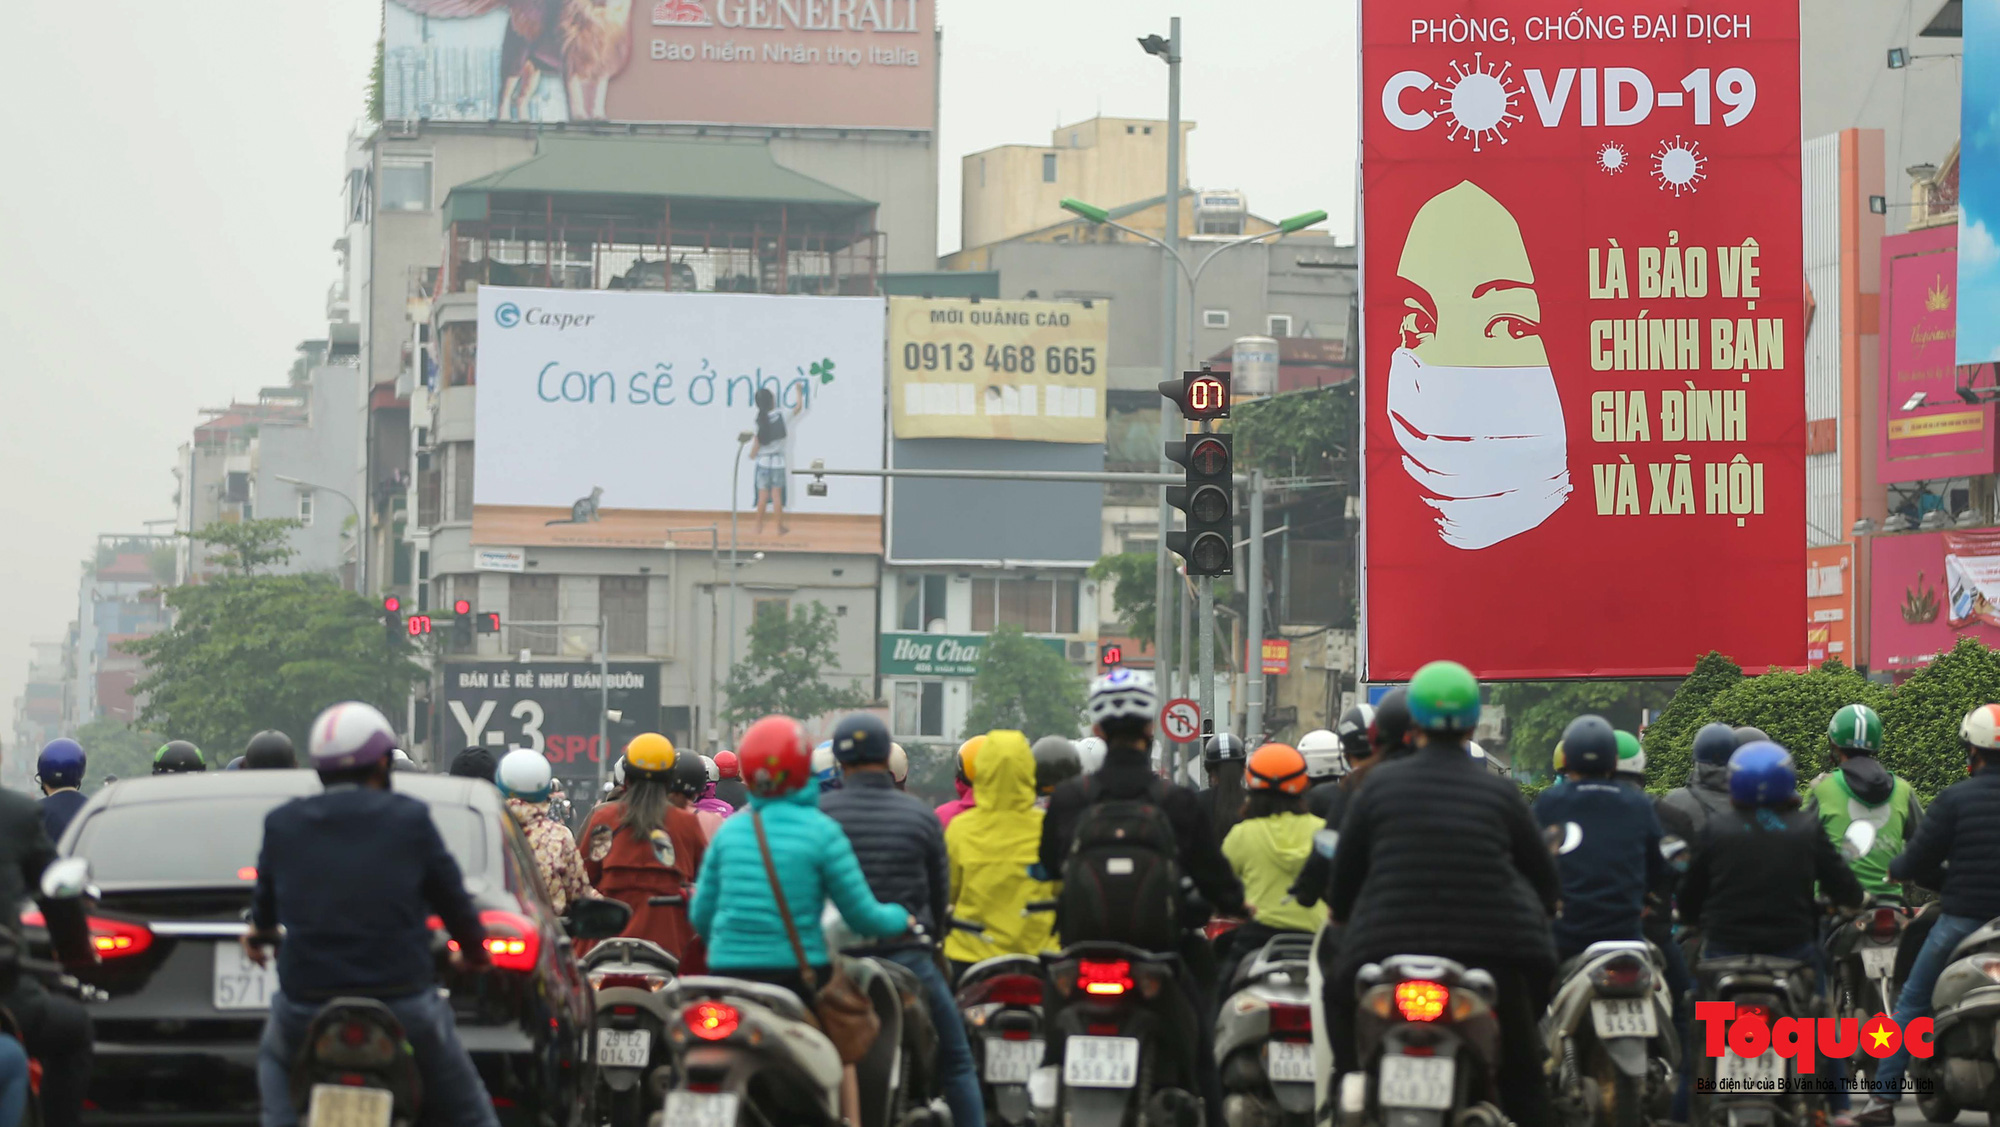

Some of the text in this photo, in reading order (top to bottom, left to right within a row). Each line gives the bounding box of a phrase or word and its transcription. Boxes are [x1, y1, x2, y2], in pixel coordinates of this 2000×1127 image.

[715, 0, 921, 33] GENERALI
[1411, 8, 1752, 45] PHÒNG, CHỐNG ĐẠI DỊCH
[869, 46, 920, 66] Italia
[1381, 58, 1758, 142] COVID-19
[1588, 230, 1761, 310] LÀ BẢO VỆ
[525, 306, 596, 331] Casper
[904, 342, 1097, 375] 0913 468 665
[1590, 309, 1784, 383] CHÍNH BẠN
[537, 357, 811, 409] Con sẽ ở nhà
[1192, 381, 1223, 409] 07
[1591, 380, 1748, 442] GIA ĐÌNH
[1592, 453, 1764, 527] VÀ XÃ HỘI
[408, 614, 432, 635] 07
[893, 638, 933, 661] Hoa
[459, 670, 488, 688] BÁN
[539, 672, 570, 688] NHƯ
[573, 671, 602, 689] BÁN
[605, 670, 645, 689] BUÔN
[448, 699, 545, 756] Y-3
[219, 974, 265, 1004] 571
